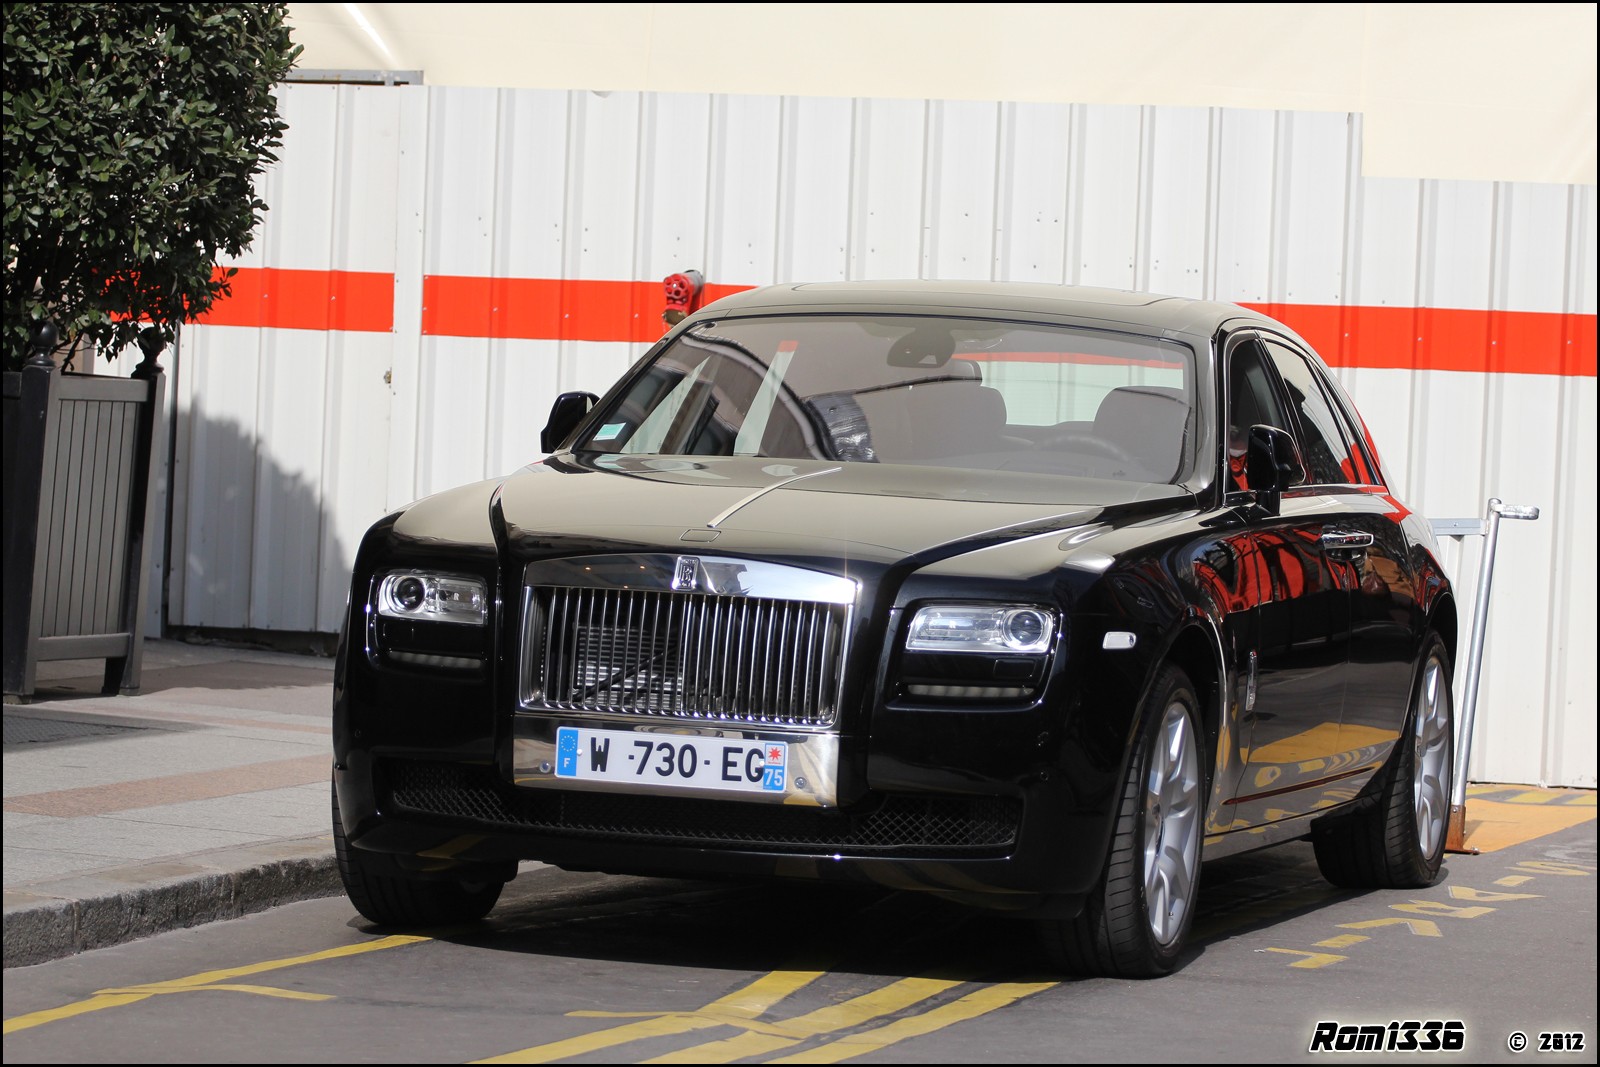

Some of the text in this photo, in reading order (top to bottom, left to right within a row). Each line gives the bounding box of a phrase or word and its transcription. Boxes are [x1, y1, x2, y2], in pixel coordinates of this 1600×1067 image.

[563, 757, 571, 768] F
[590, 737, 610, 773] W
[721, 746, 765, 783] EG
[764, 768, 783, 786] 75
